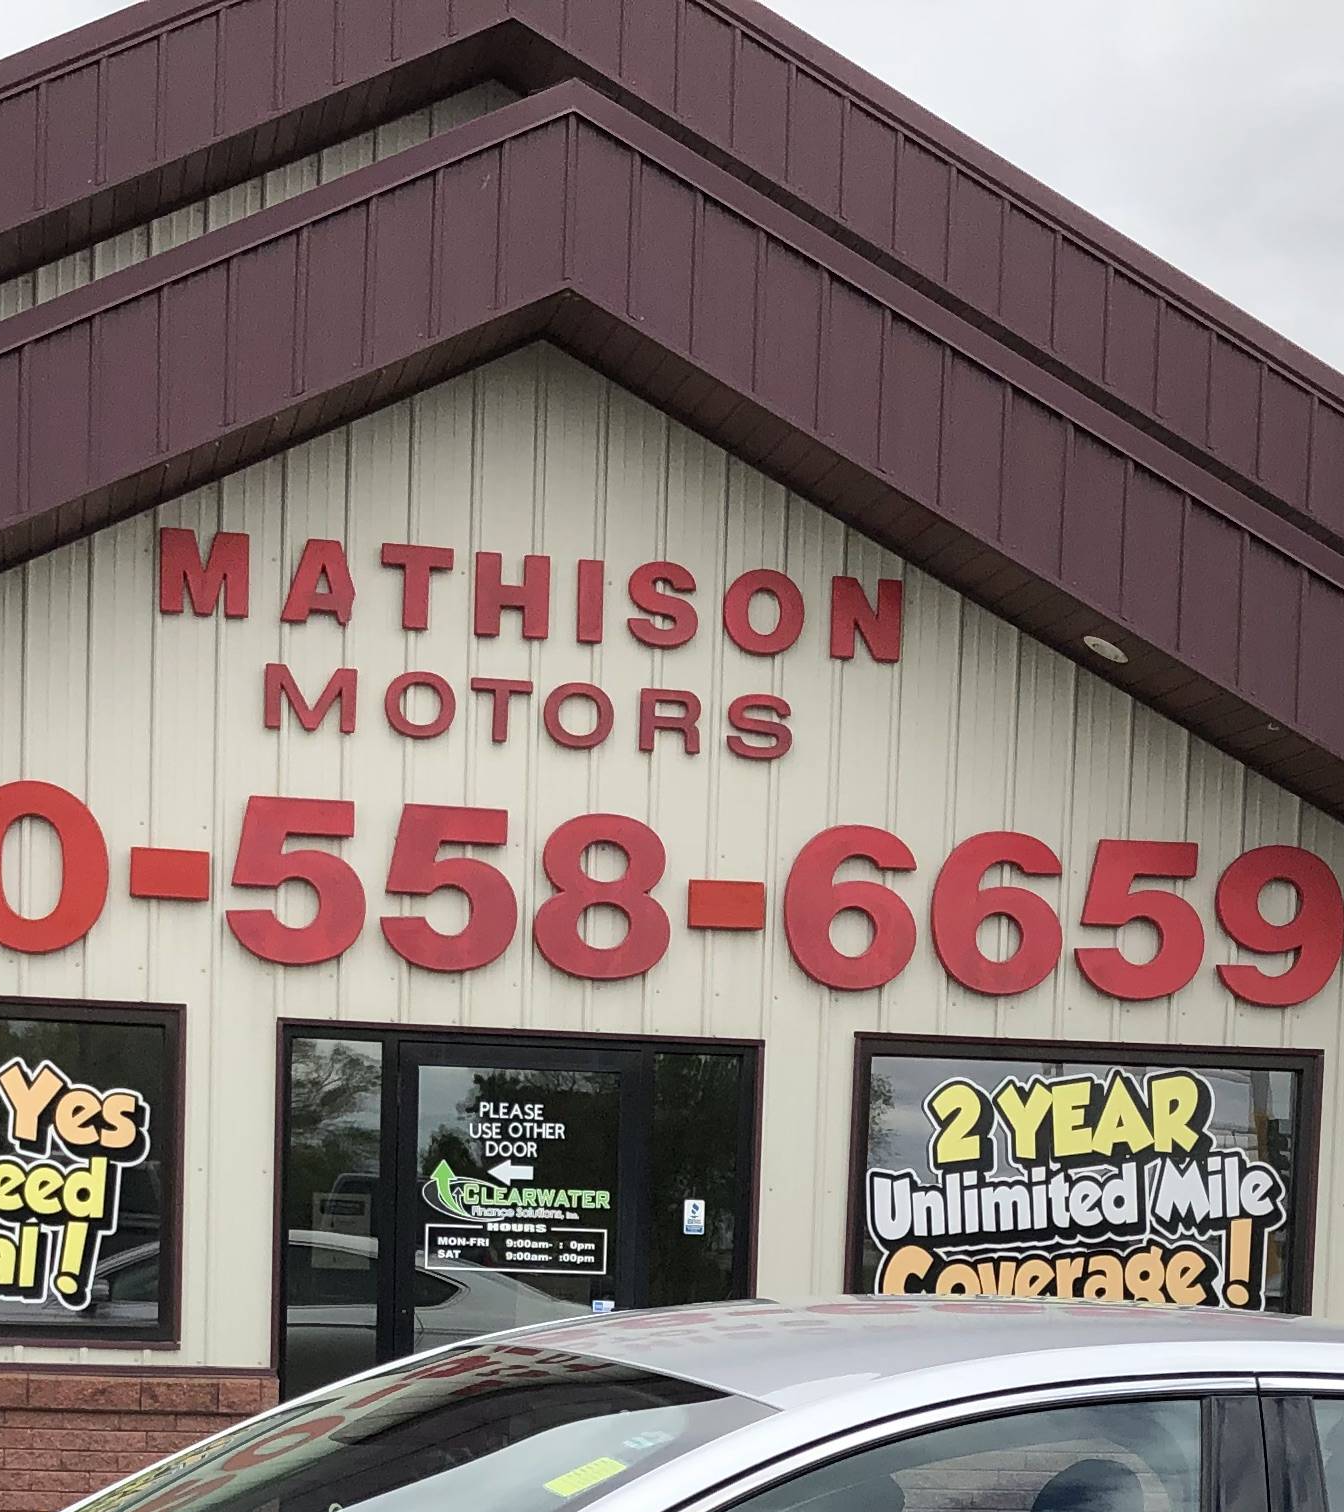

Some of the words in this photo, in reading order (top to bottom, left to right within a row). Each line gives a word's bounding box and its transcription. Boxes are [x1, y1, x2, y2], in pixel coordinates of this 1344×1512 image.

[159, 526, 903, 664] MATHISON
[263, 662, 793, 760] MOTORS
[479, 1101, 544, 1120] PLEASE
[930, 1082, 984, 1165] 2
[995, 1071, 1201, 1161] YEAR
[469, 1123, 501, 1139] USE
[508, 1122, 565, 1140] OTHER
[485, 1141, 538, 1158] DOOR
[463, 1183, 610, 1209] CLEARWATER
[871, 1160, 1140, 1241] Unlimited
[1153, 1155, 1276, 1224] Mile
[471, 1205, 515, 1218] Finance
[487, 1223, 547, 1233] HOURS
[437, 1236, 490, 1247] MON-FRI
[437, 1249, 461, 1259] SAT
